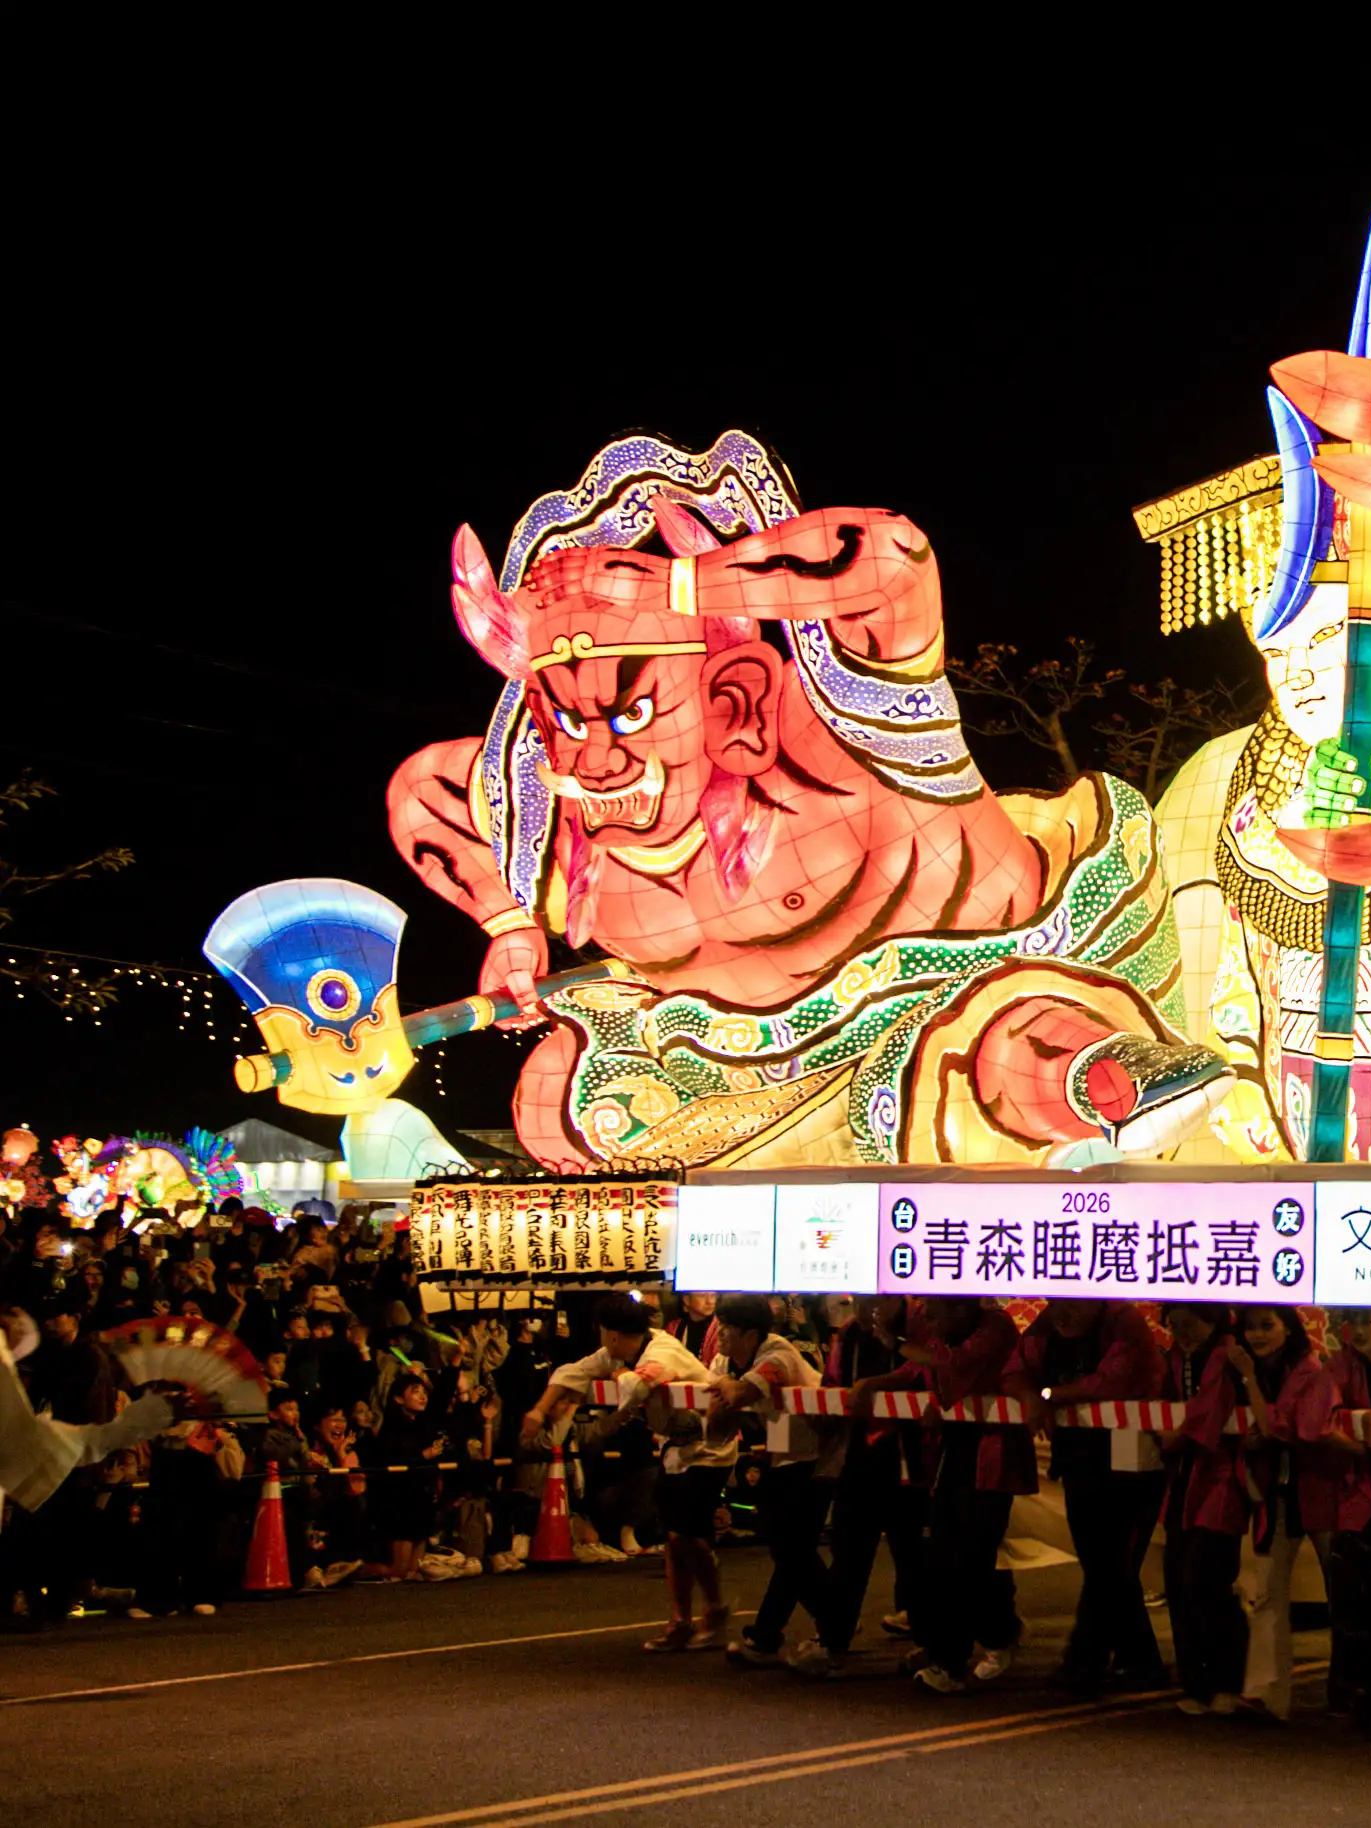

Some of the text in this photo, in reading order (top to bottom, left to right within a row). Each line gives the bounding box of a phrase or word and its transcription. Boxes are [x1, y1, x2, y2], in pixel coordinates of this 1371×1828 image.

[1061, 1192, 1111, 1213] 2026
[689, 1230, 737, 1246] everrich
[892, 1200, 917, 1277] 台日
[923, 1217, 1261, 1287] 青森睡魔抵嘉
[1274, 1202, 1302, 1280] 友好
